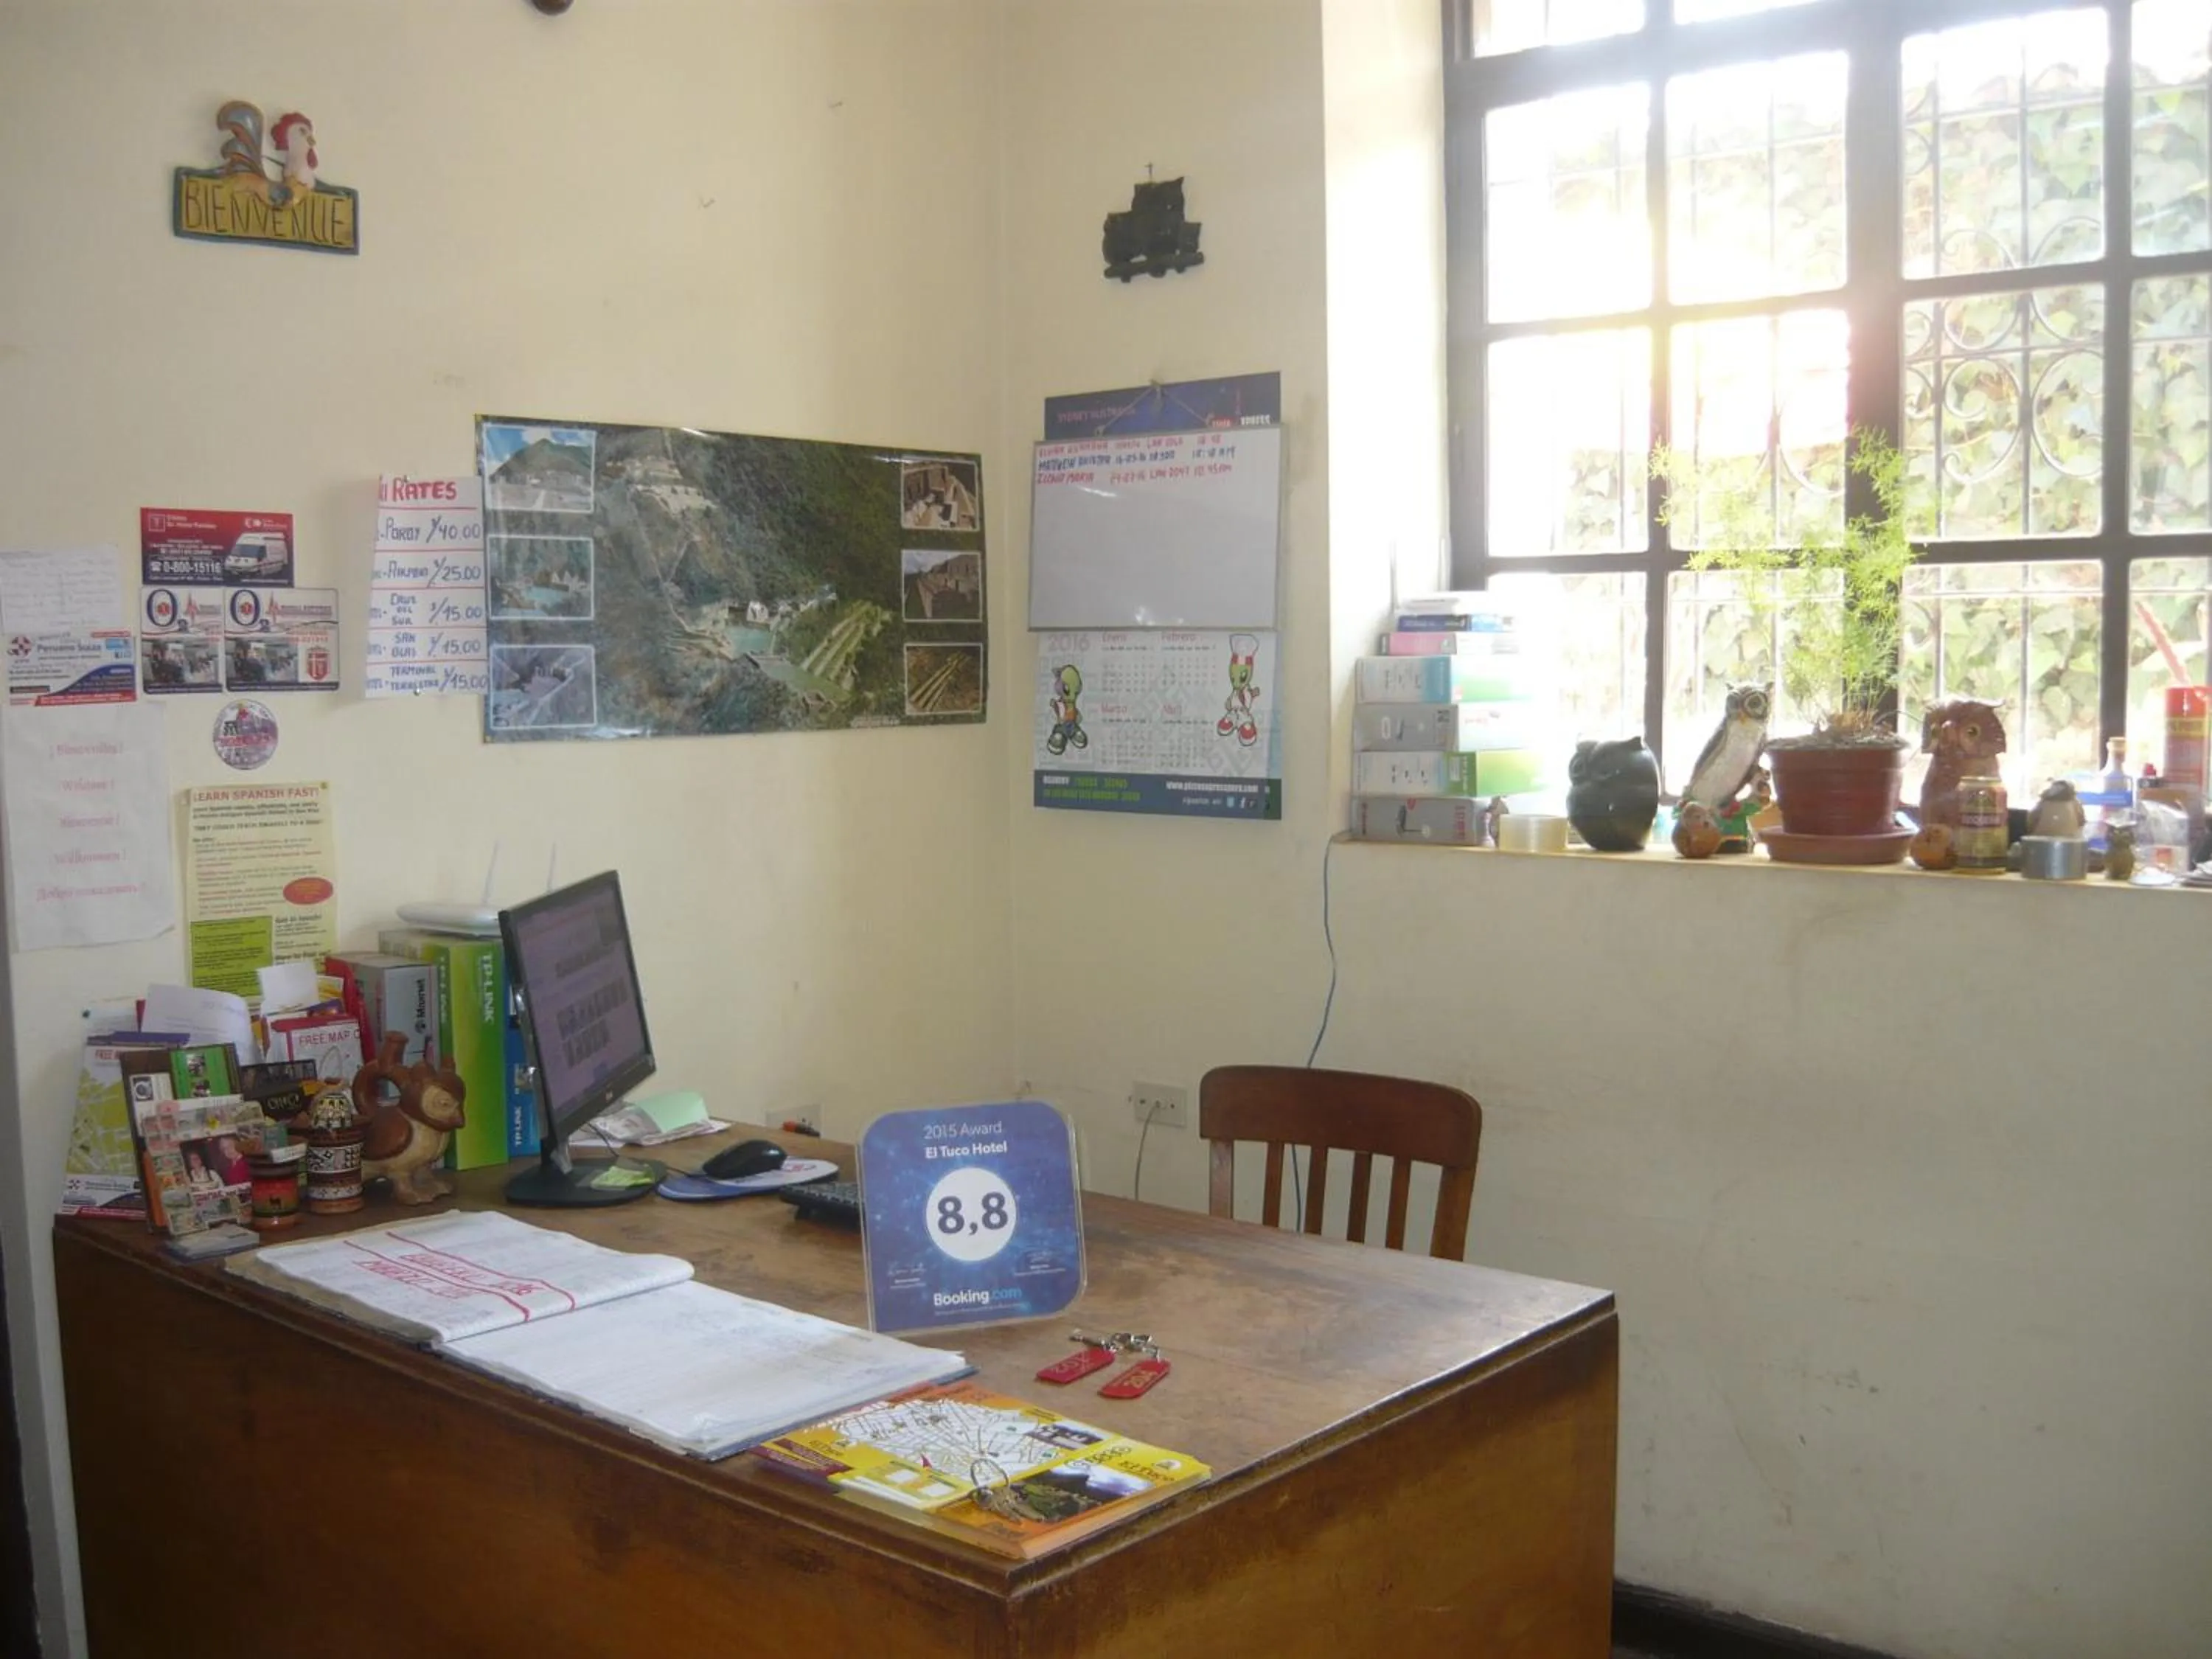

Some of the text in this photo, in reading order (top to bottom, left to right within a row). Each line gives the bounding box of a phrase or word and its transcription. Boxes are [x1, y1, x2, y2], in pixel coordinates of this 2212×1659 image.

[392, 477, 458, 502] RATES
[1048, 634, 1090, 652] 2016
[195, 792, 229, 802] LEARN
[233, 788, 285, 800] SPANISH
[484, 952, 495, 1024] TP-LINK
[923, 1121, 1003, 1140] 2015 Award
[925, 1141, 1008, 1158] El Tuco Hotel
[937, 1192, 1009, 1235] 8,8
[933, 1287, 1022, 1307] Booking.com
